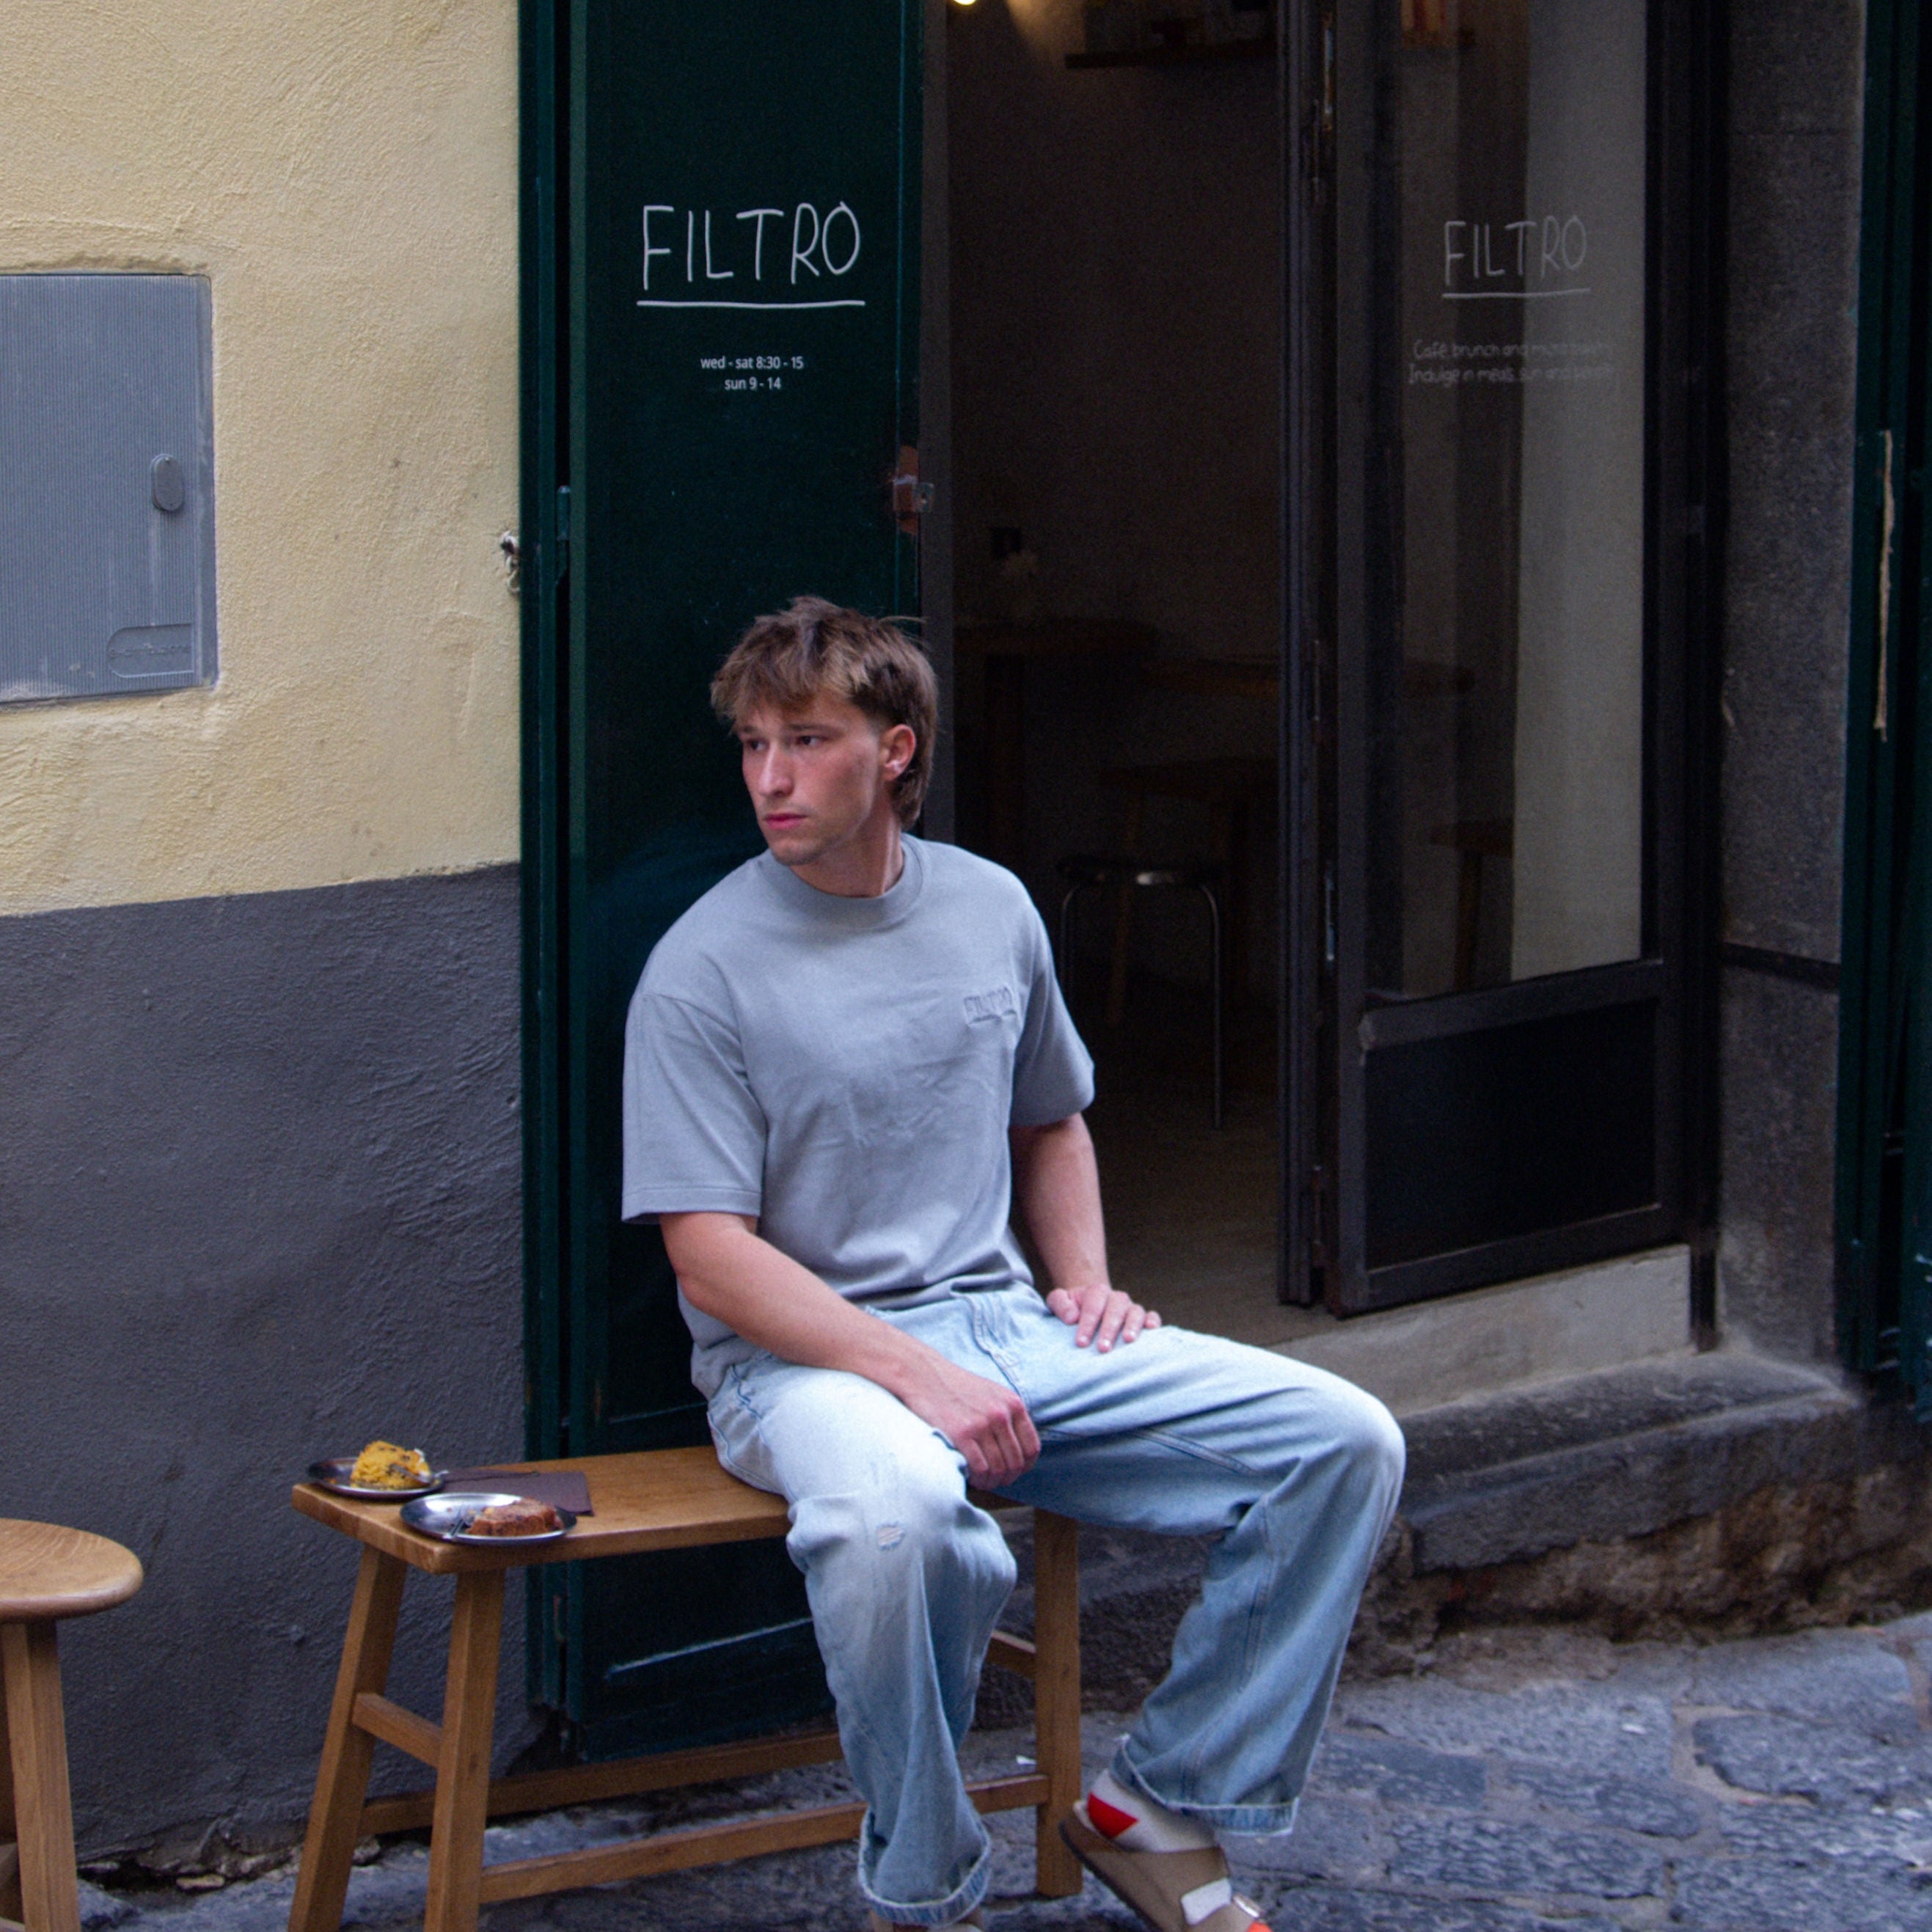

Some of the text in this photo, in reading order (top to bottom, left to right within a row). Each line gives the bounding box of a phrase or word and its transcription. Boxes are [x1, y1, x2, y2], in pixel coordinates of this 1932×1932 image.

[643, 201, 860, 290] FILTRO
[1444, 215, 1586, 285] FILTRO
[700, 356, 726, 369] wed
[735, 357, 753, 369] sat
[756, 356, 780, 369] 8:30
[791, 356, 804, 369] 15
[725, 378, 747, 390] sun
[749, 376, 757, 390] 9
[767, 377, 781, 390] 14
